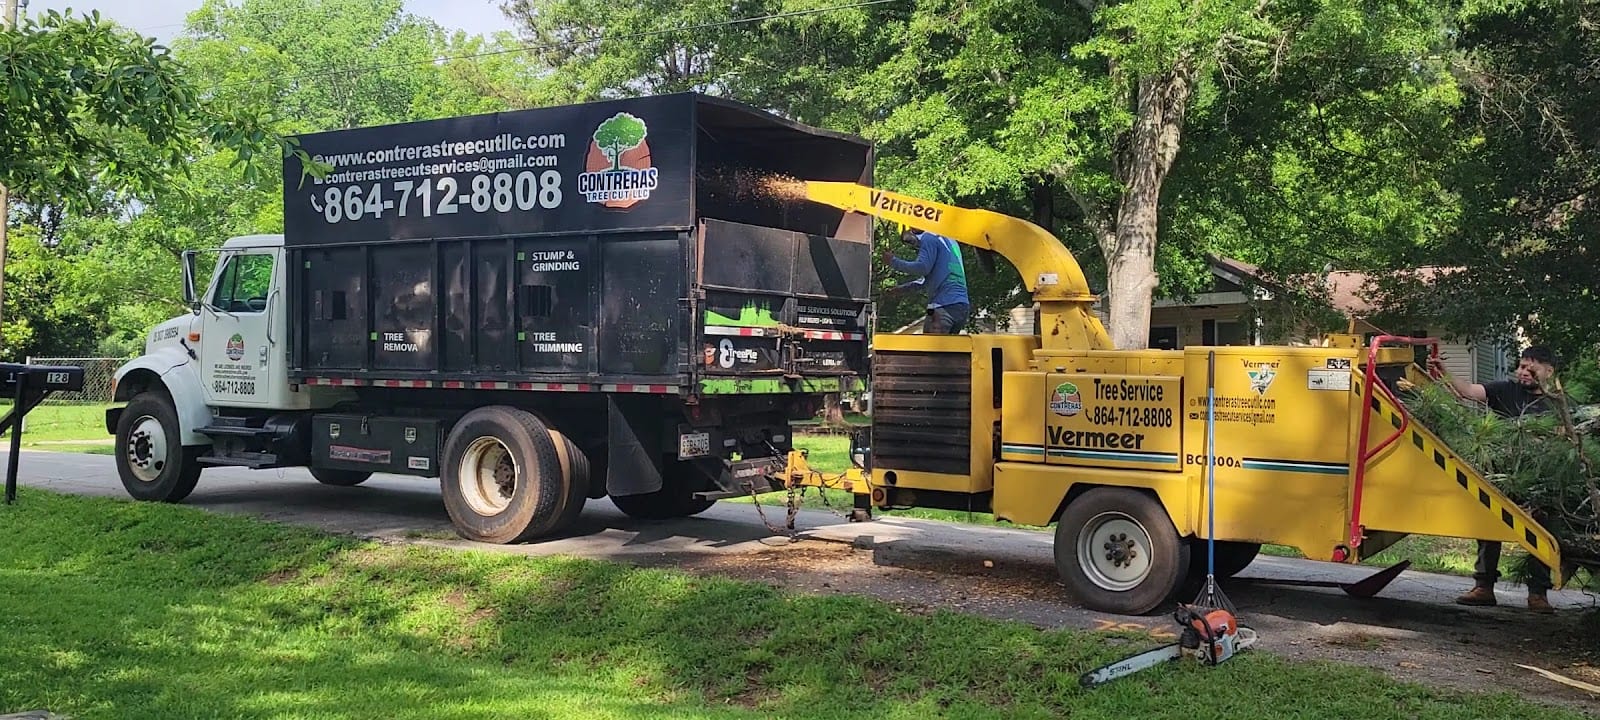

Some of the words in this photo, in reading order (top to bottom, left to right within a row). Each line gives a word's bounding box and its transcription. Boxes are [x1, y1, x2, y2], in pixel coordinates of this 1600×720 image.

[324, 133, 566, 167] www.contrerastreecutllc.com
[325, 153, 558, 185] contrerastreecutservices@gmail.com
[579, 169, 658, 193] CONTRERAS
[324, 169, 563, 224] 864-712-8808
[587, 191, 609, 202] TREE
[612, 190, 630, 200] CUT
[632, 188, 649, 199] LLC
[870, 191, 943, 221] Vermeer
[532, 250, 565, 262] STUMP
[566, 250, 575, 260] &
[532, 261, 580, 272] GRINDING
[807, 306, 830, 315] SERVICES
[830, 308, 858, 317] SOLUTIONS
[383, 332, 405, 341] TREE
[533, 332, 557, 342] TREE
[383, 342, 419, 352] REMOVA
[533, 343, 583, 353] TRIMMING
[49, 373, 68, 382] 128
[214, 380, 255, 395] 864-712-8808
[1093, 378, 1118, 401] Tree
[1120, 378, 1164, 402] Service
[1050, 402, 1082, 410] CONTRERAS
[1197, 395, 1276, 409] wwwontrerastreecutllc.com
[1094, 405, 1172, 428] 864-712-8808
[1199, 409, 1276, 426] conastreecutservicesgmail.com
[1047, 425, 1145, 450] Vermeer
